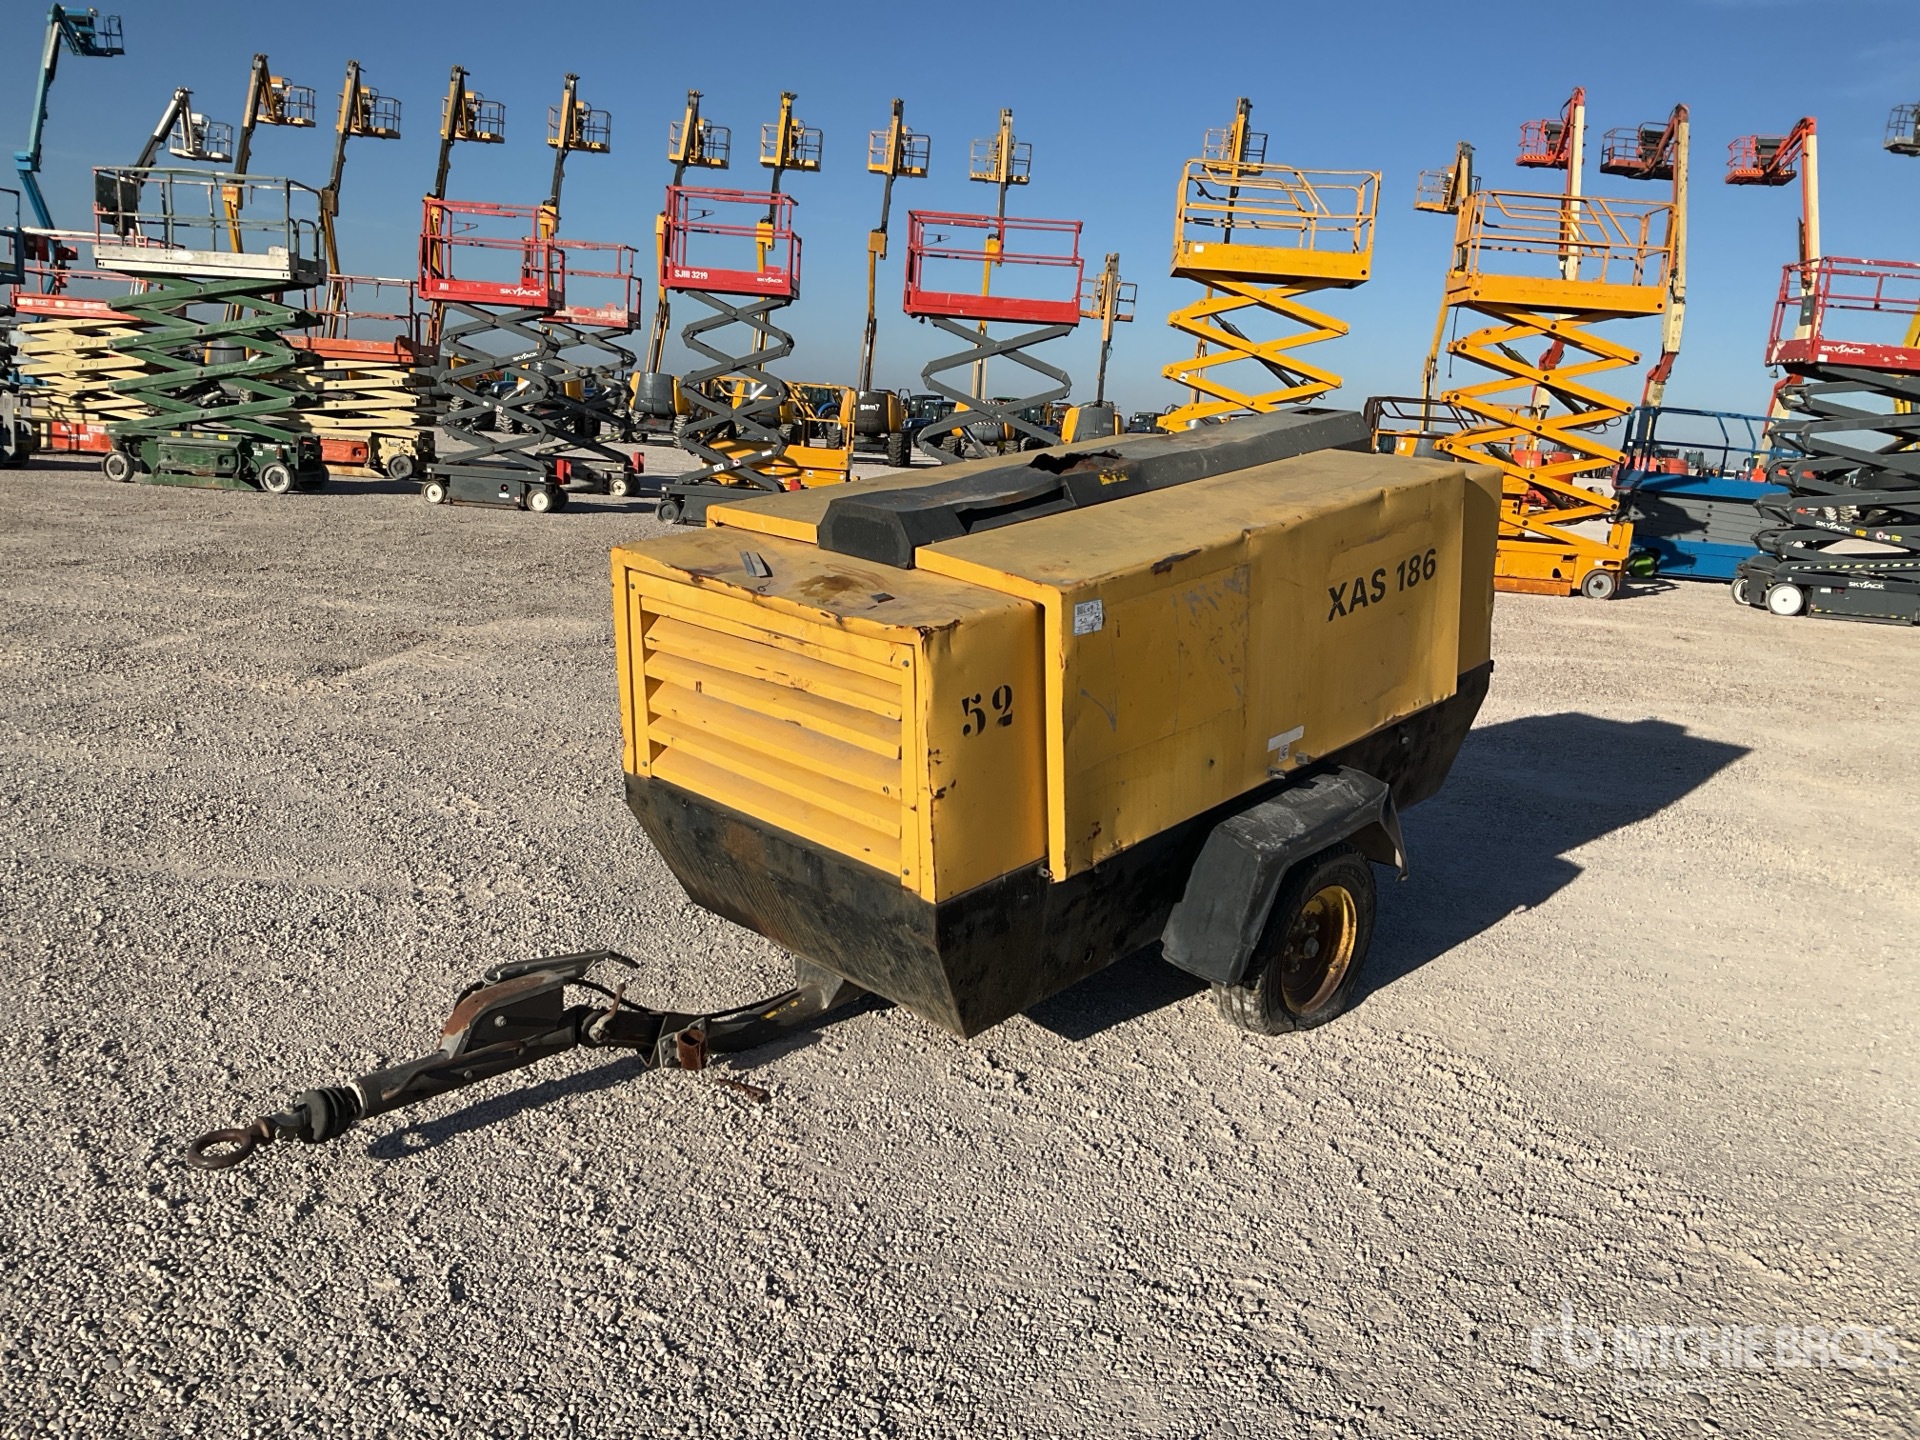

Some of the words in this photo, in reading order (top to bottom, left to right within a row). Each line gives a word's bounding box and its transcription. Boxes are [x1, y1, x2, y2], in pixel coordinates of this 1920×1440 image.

[691, 271, 708, 280] 3219
[757, 276, 783, 284] SKYJACK
[500, 287, 541, 297] SKYJACK
[1820, 343, 1866, 355] SKYJACK
[512, 351, 538, 361] SKYJACK
[1815, 520, 1851, 533] SKYJACK
[1327, 567, 1386, 622] XAS
[1396, 548, 1437, 593] 186
[1848, 581, 1885, 590] SKYJACK
[961, 684, 1013, 737] 52
